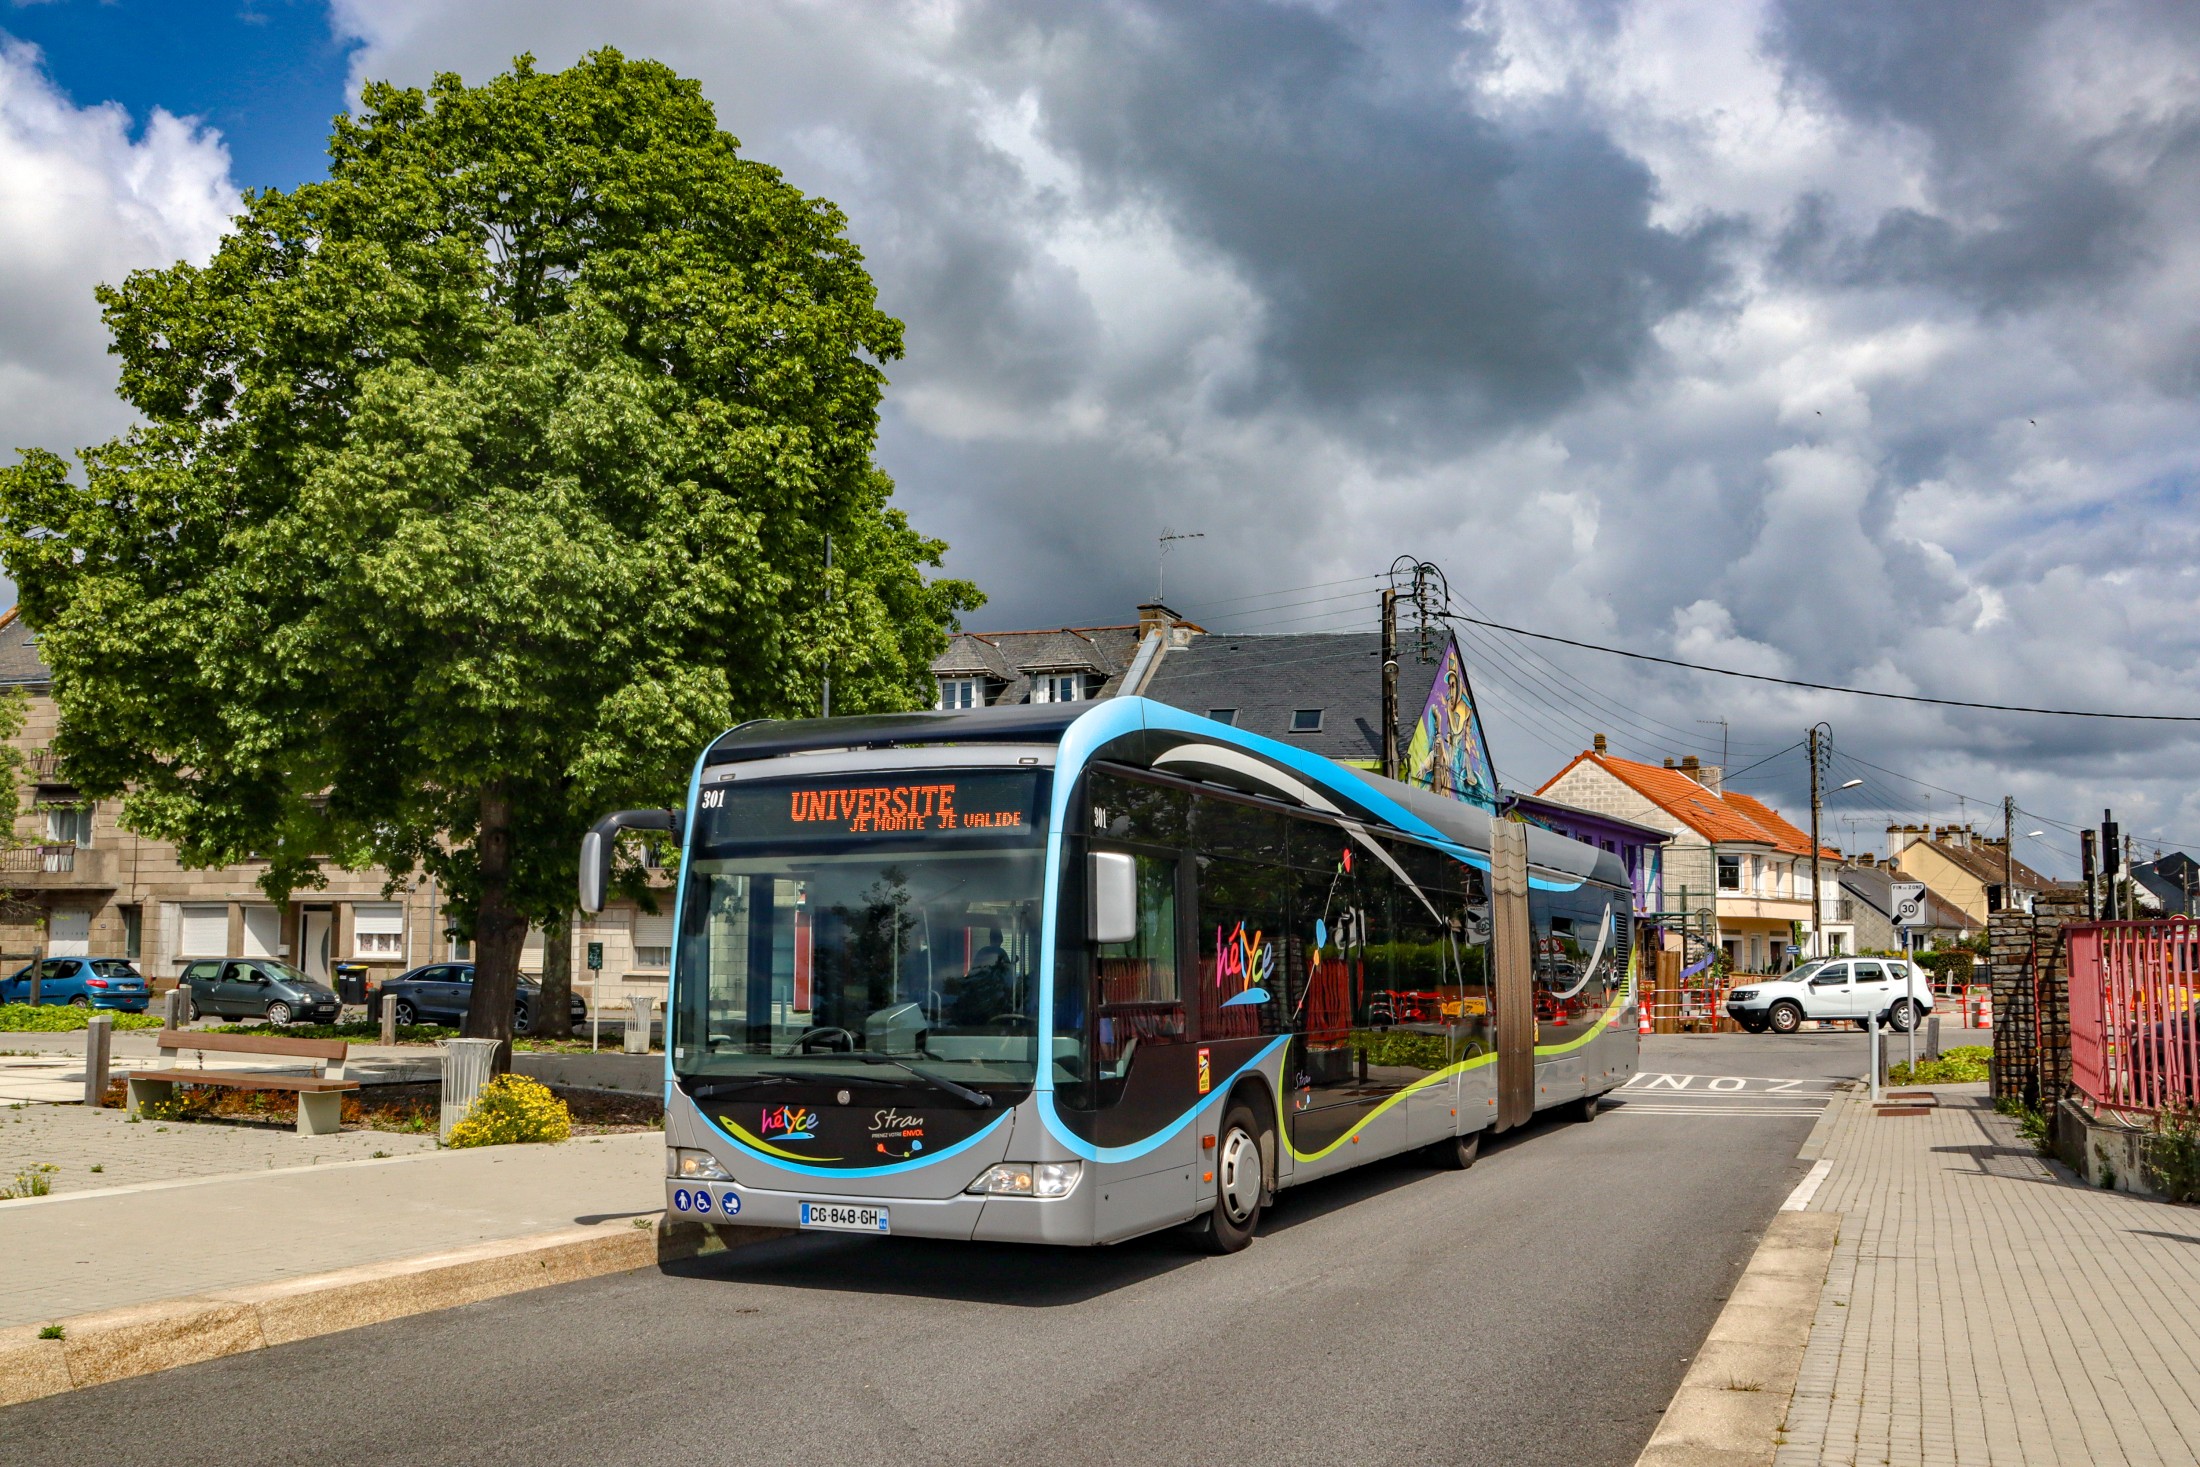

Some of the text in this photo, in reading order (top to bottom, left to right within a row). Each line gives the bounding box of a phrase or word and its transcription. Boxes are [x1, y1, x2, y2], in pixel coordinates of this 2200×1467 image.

[701, 790, 725, 809] 301
[791, 785, 956, 822] UNIVERSITE
[849, 811, 1021, 832] JE MONTE JE VALIDE
[1094, 806, 1107, 829] 301
[1902, 904, 1915, 913] 30
[868, 1107, 924, 1131] Stran
[902, 1129, 924, 1137] ENVOL
